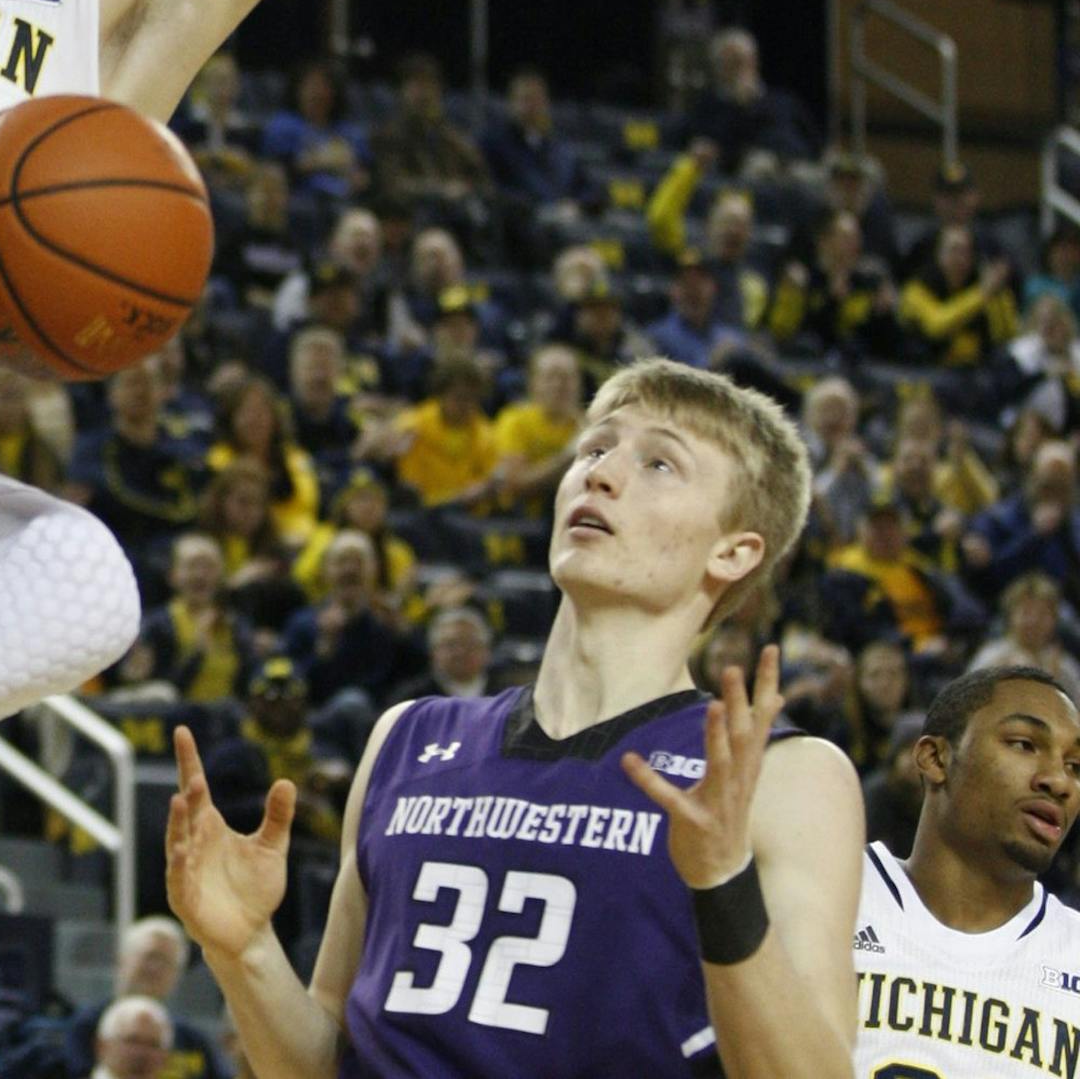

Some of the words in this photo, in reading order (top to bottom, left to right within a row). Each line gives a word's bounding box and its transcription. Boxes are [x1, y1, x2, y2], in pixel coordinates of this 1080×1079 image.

[385, 795, 661, 856] NORTHWESTERN
[384, 861, 576, 1035] 32
[853, 940, 886, 953] didas
[856, 972, 1080, 1079] ICHIGAN
